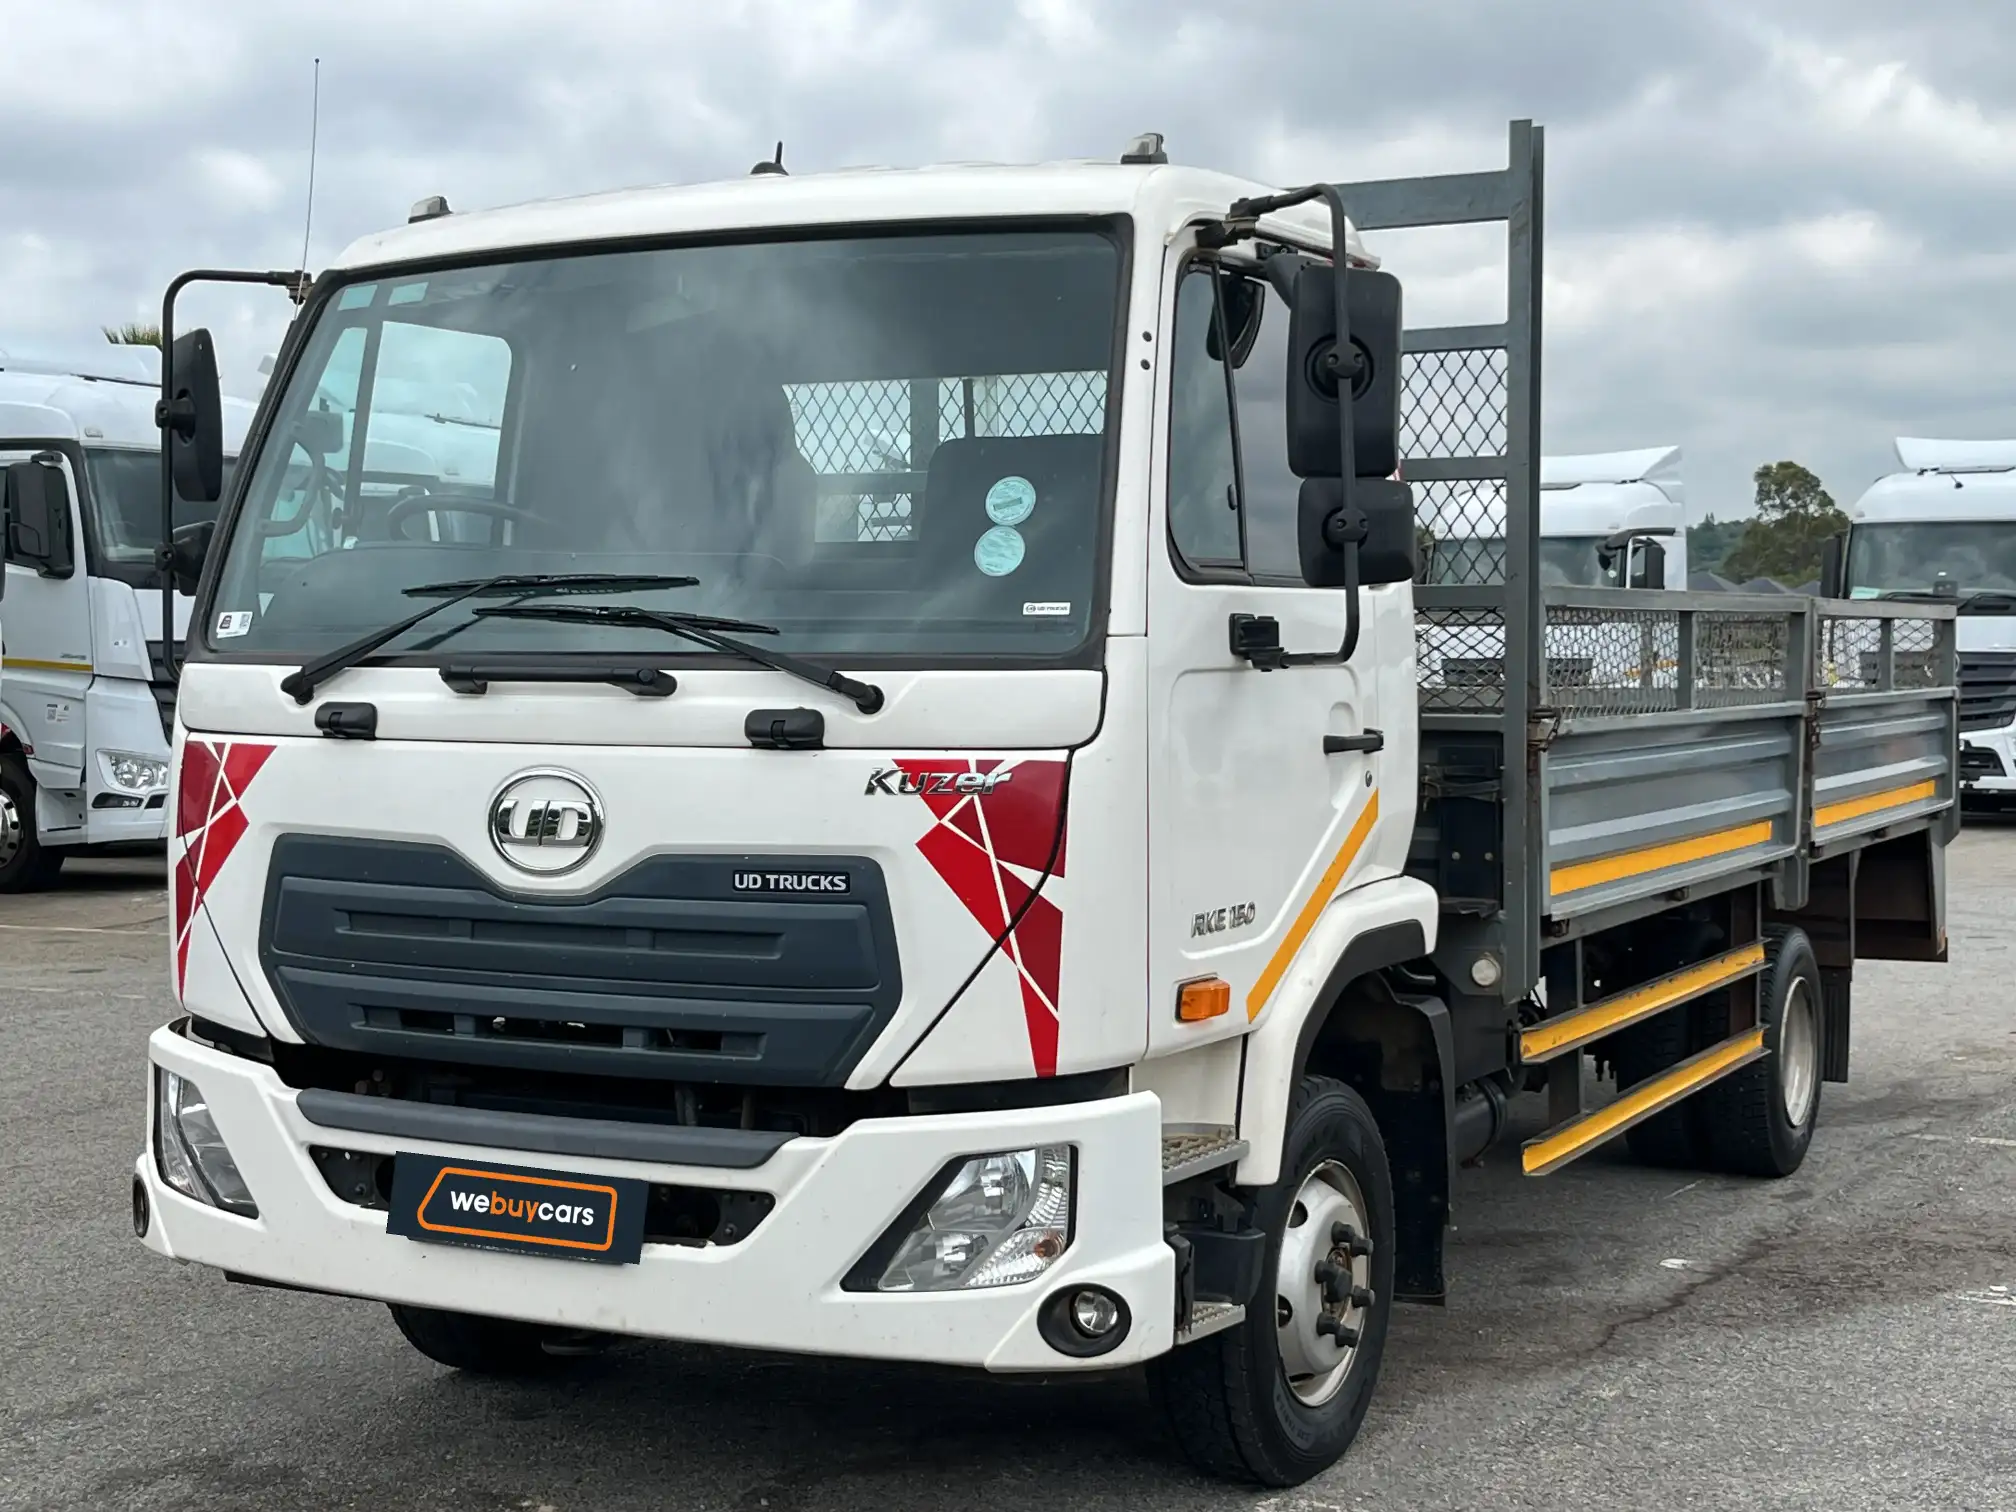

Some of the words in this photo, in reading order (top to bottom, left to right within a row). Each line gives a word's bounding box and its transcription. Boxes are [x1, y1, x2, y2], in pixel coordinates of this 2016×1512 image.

[864, 767, 1012, 796] Kuzer
[498, 798, 593, 847] UD
[734, 873, 762, 889] UD
[765, 874, 847, 890] TRUCKS
[1191, 908, 1227, 938] RKE
[1228, 901, 1256, 929] 150
